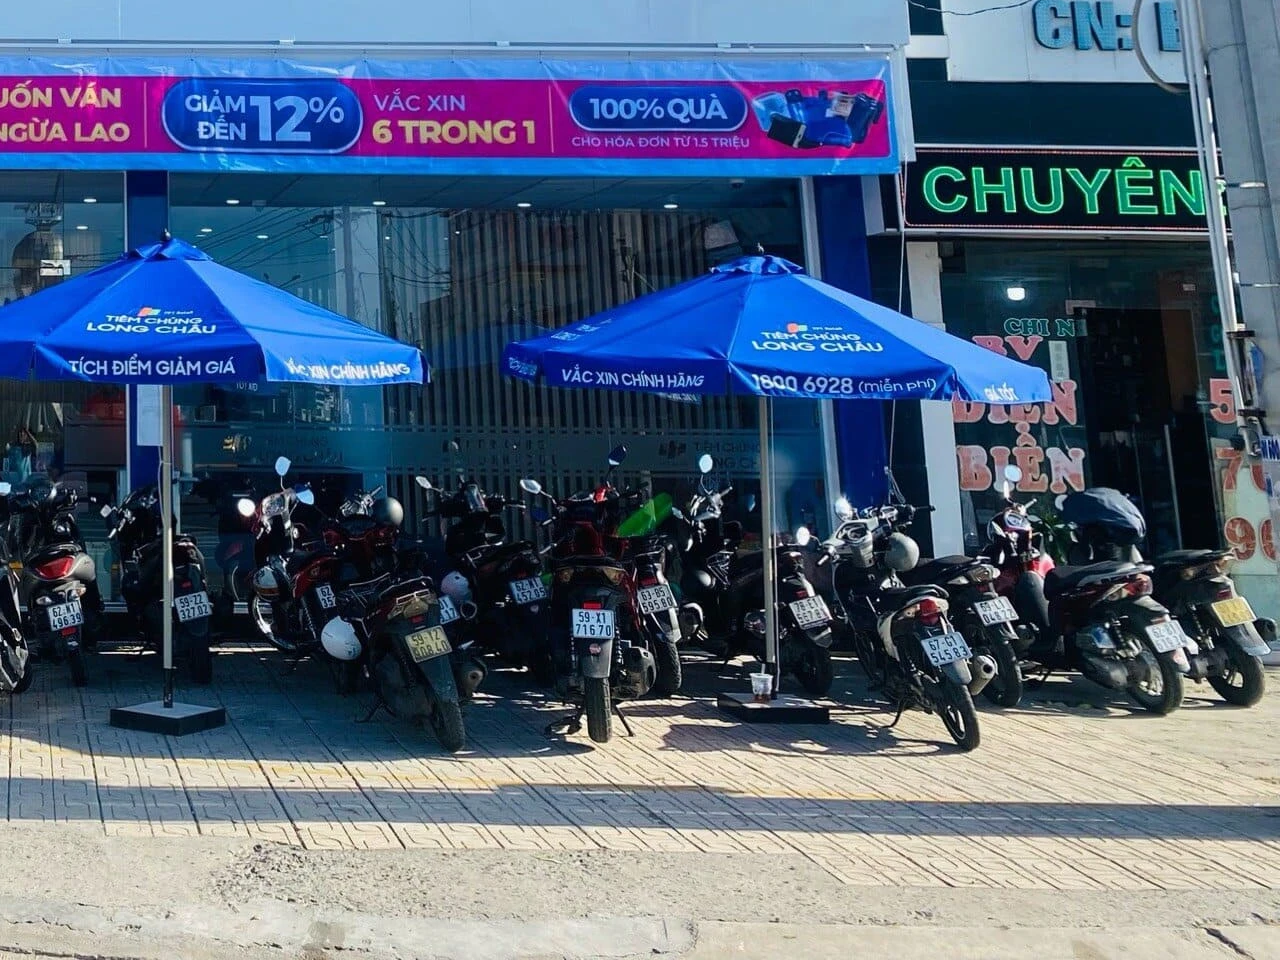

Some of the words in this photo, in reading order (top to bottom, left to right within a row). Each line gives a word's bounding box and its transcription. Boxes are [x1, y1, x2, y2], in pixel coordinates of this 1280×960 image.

[59, 80, 122, 108] VÁN
[185, 90, 246, 113] GIẢM
[373, 88, 421, 112] VẮC
[426, 94, 467, 112] XIN
[249, 95, 345, 142] 12%
[589, 98, 665, 121] 100%
[667, 93, 729, 123] QUÀ
[75, 122, 131, 143] LAO
[197, 116, 246, 141] ĐẾN
[372, 119, 393, 144] 6
[398, 119, 517, 144] TRONG
[523, 119, 536, 144] 1
[572, 136, 600, 148] CHO
[604, 132, 635, 148] HÓA
[637, 135, 670, 148] ĐƠN
[711, 136, 750, 149] TRIỆU
[923, 156, 1207, 216] CHUYÊN
[86, 321, 149, 333] LONG
[155, 323, 217, 334] CHÂU
[1004, 318, 1050, 336] CHI
[752, 340, 816, 351] LONG
[820, 340, 884, 352] CHÂU
[69, 354, 110, 377] TÍCH
[112, 352, 154, 377] ĐIỂM
[156, 353, 203, 377] GIẢM
[205, 354, 236, 376] GIÁ
[562, 364, 594, 383] VẮC
[595, 371, 619, 385] XIN
[621, 370, 665, 388] CHÍNH
[753, 372, 801, 393] 1800
[803, 375, 854, 394] 6928
[578, 611, 606, 623] 59-X1
[928, 632, 959, 650] 67-G1
